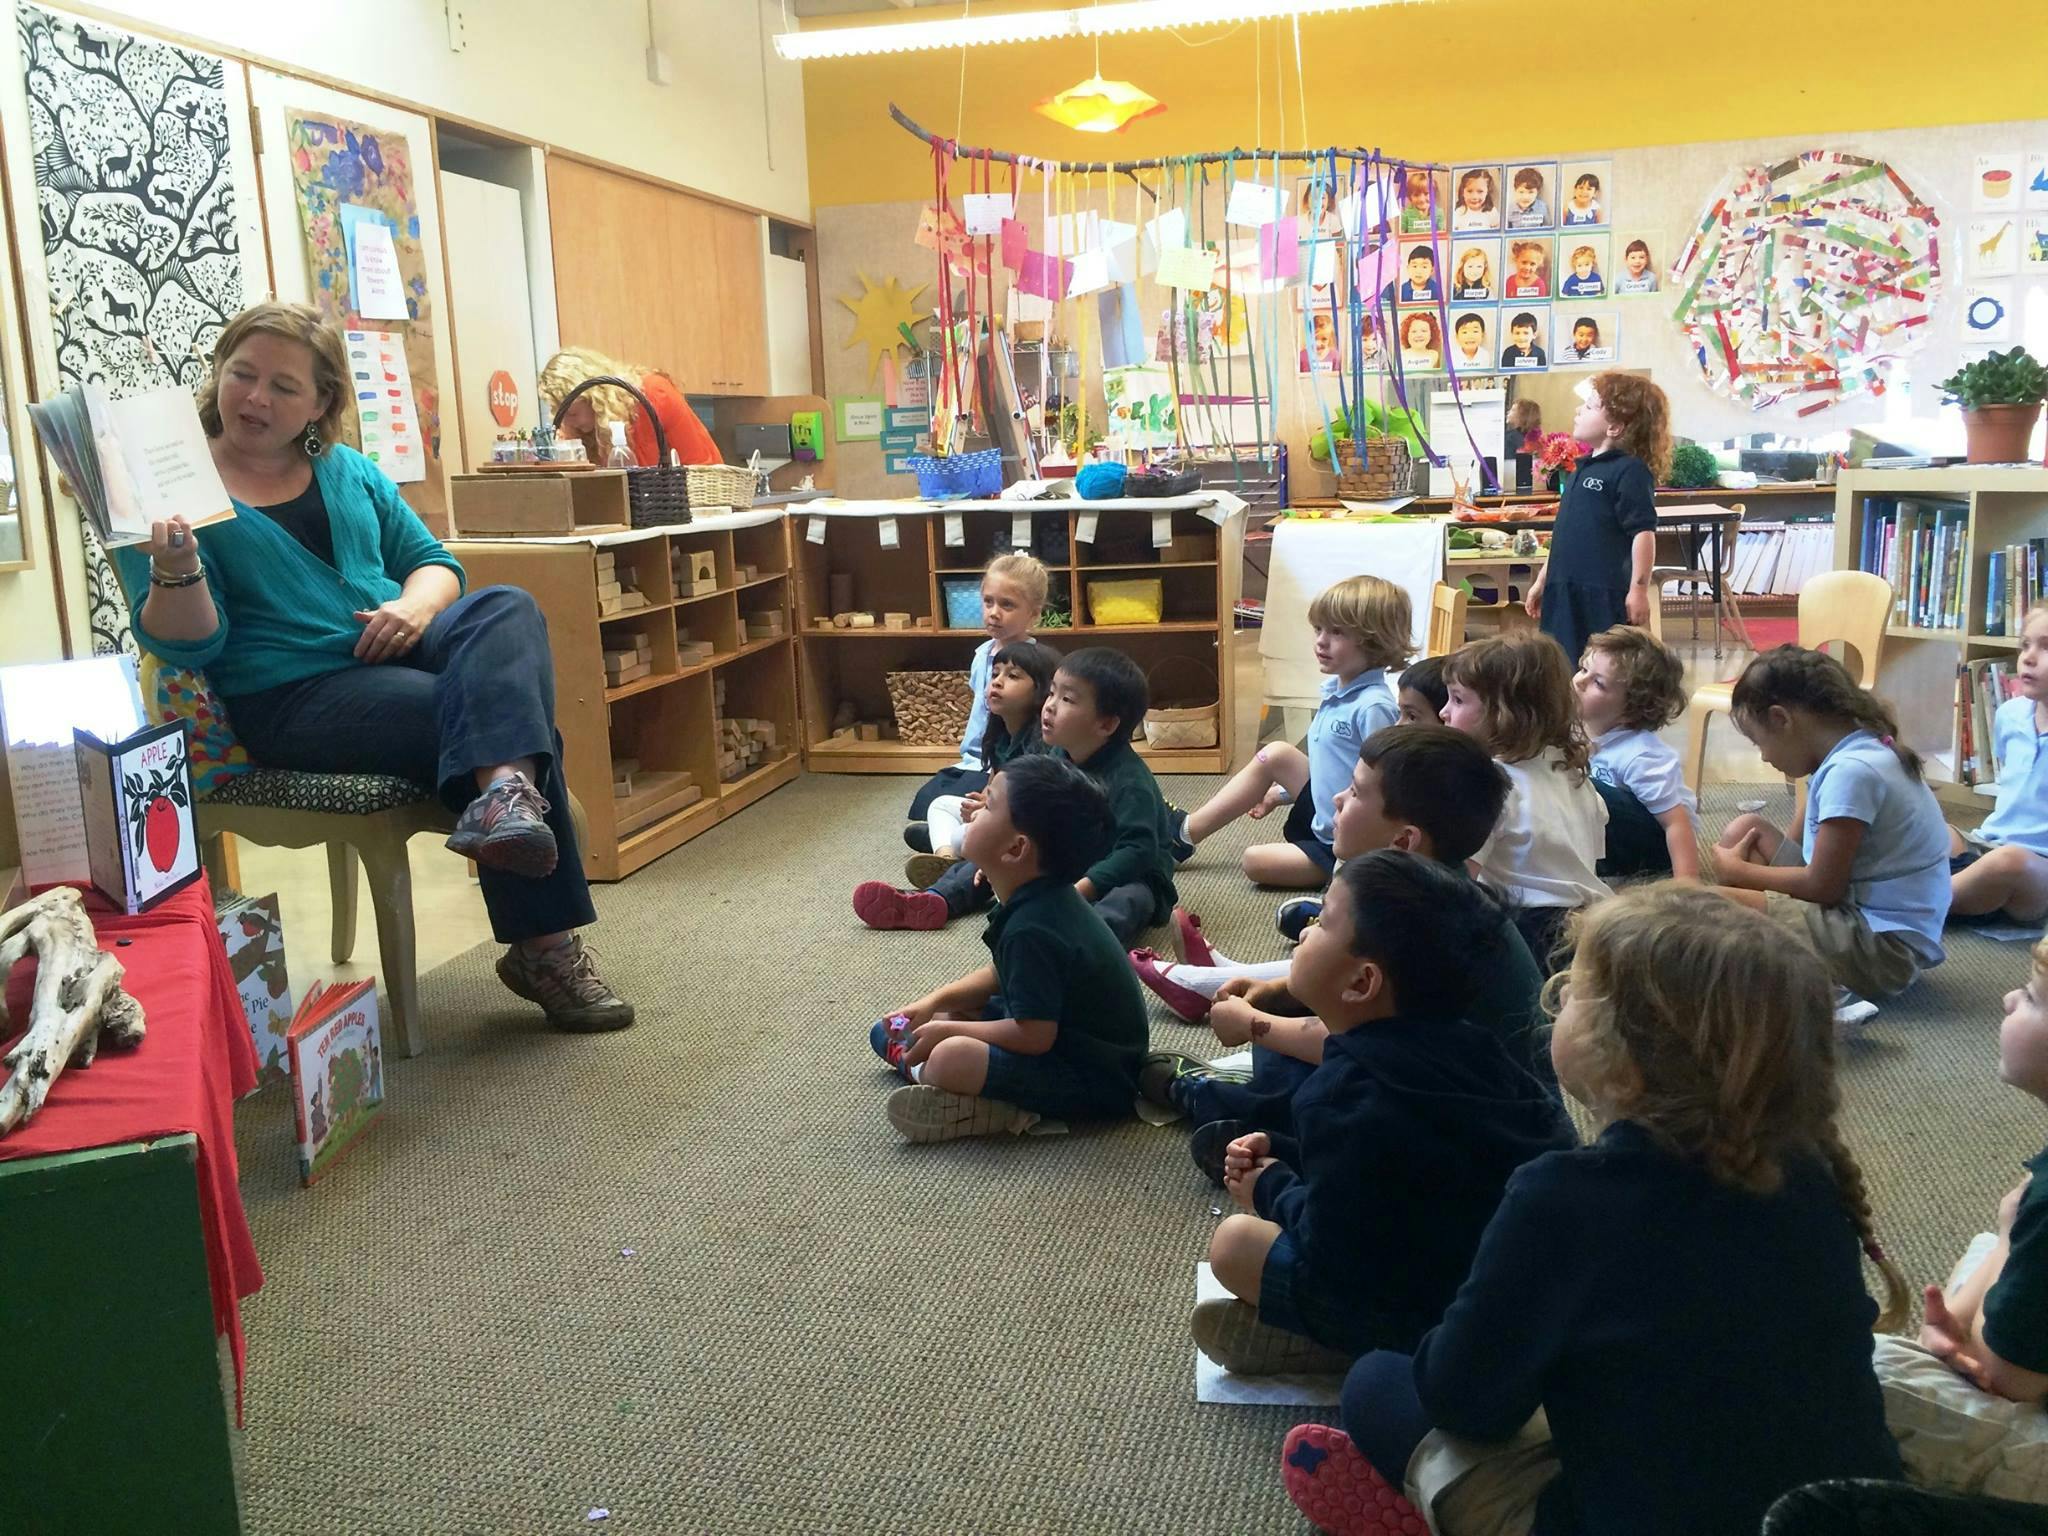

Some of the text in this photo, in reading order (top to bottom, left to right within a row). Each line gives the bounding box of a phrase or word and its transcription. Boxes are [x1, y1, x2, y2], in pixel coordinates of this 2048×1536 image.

[493, 381, 518, 417] stop
[1582, 477, 1605, 492] OES
[141, 742, 168, 769] APPLE
[251, 996, 270, 1014] Pie
[317, 1035, 331, 1058] TEN
[330, 1021, 344, 1042] RED
[342, 1011, 366, 1030] APPLES
